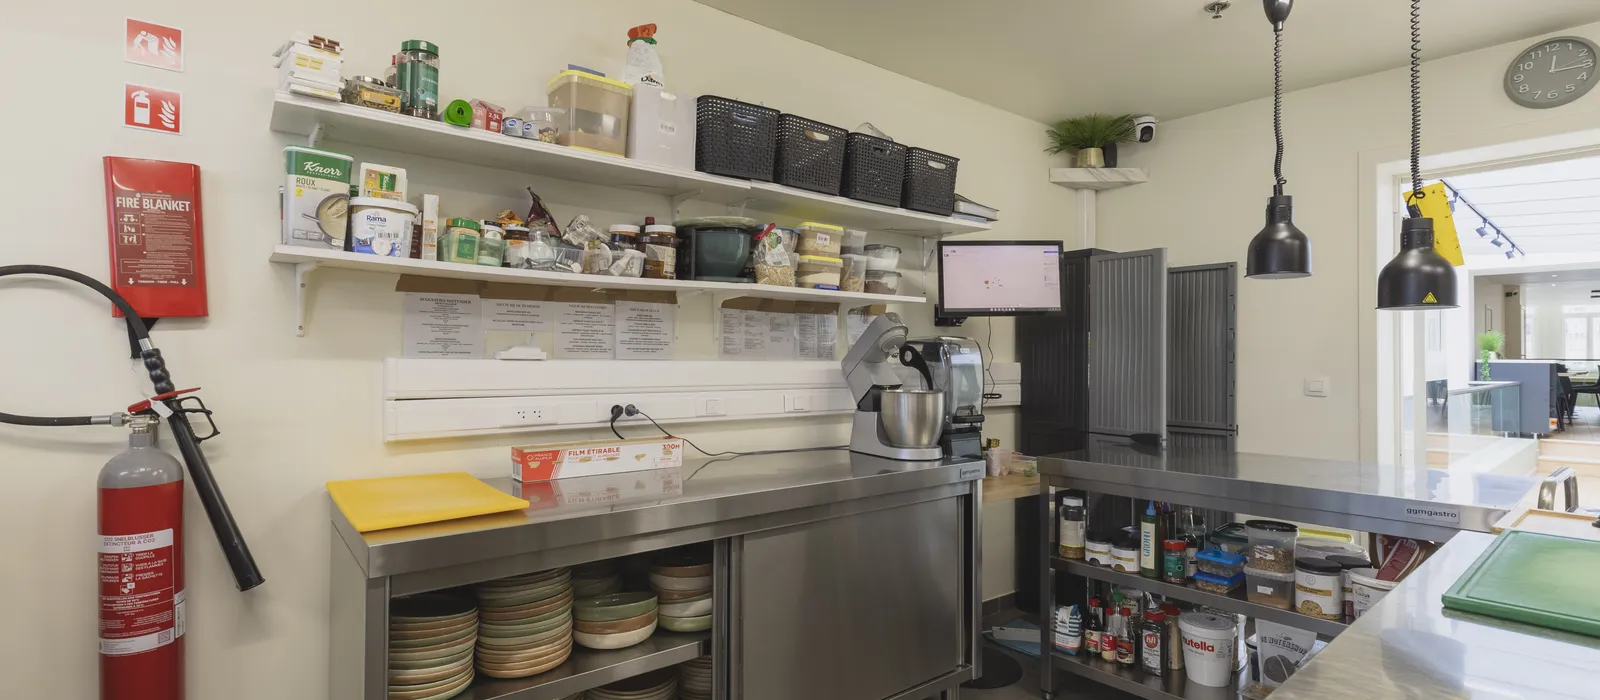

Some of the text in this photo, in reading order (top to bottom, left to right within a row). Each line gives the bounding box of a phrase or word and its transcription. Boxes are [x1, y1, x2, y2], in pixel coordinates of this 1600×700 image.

[1544, 43, 1560, 52] 12
[1578, 48, 1588, 56] 2
[1530, 50, 1542, 59] 11
[1518, 62, 1534, 70] 10
[1514, 74, 1524, 82] 9
[1576, 72, 1588, 80] 4
[1519, 84, 1530, 92] 8
[1566, 84, 1576, 92] 5
[1532, 90, 1542, 100] 7
[1547, 90, 1558, 98] 6
[304, 161, 342, 176] Knorr
[296, 176, 316, 186] ROUX
[116, 196, 140, 208] FIRE
[142, 198, 190, 212] BLANKET
[587, 446, 620, 455] ÉTIRABLE
[1406, 507, 1457, 518] ggmgastro
